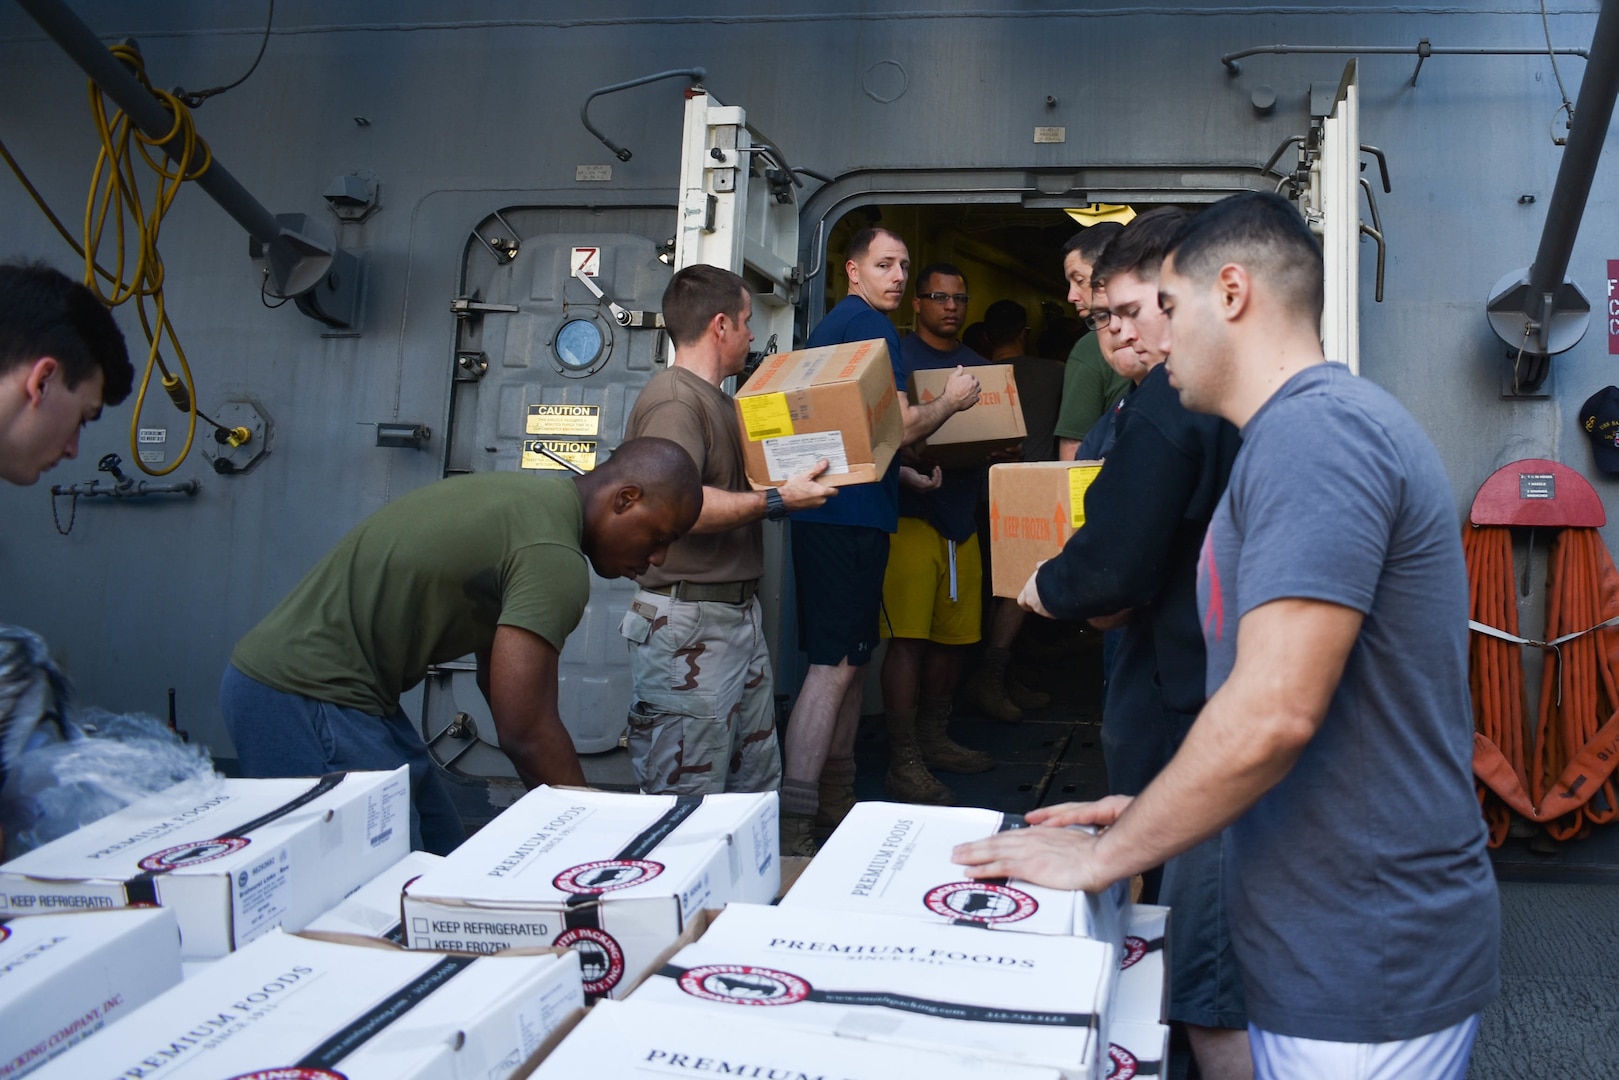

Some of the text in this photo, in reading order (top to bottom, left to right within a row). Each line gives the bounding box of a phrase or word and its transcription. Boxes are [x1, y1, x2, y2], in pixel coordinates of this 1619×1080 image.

[538, 406, 591, 416] CAUTION
[977, 391, 1001, 406] OZEN
[1003, 515, 1051, 542] KEEP FROZEN
[86, 822, 172, 860] PREMIUM
[172, 794, 230, 822] FOODS
[486, 806, 586, 878] PREMIUM FOODS
[851, 819, 914, 897] PREMIUM FOODS
[10, 895, 113, 908] KEEP REFRIGERATED
[432, 920, 549, 936] KEEP REFRIGERATED
[435, 940, 463, 951] KEEP
[578, 928, 621, 959] PACKING
[769, 938, 1036, 969] PREMIUM FOODS
[846, 954, 901, 962] SINCE
[113, 1012, 237, 1080] REMIUM
[231, 965, 313, 1012] FOODS
